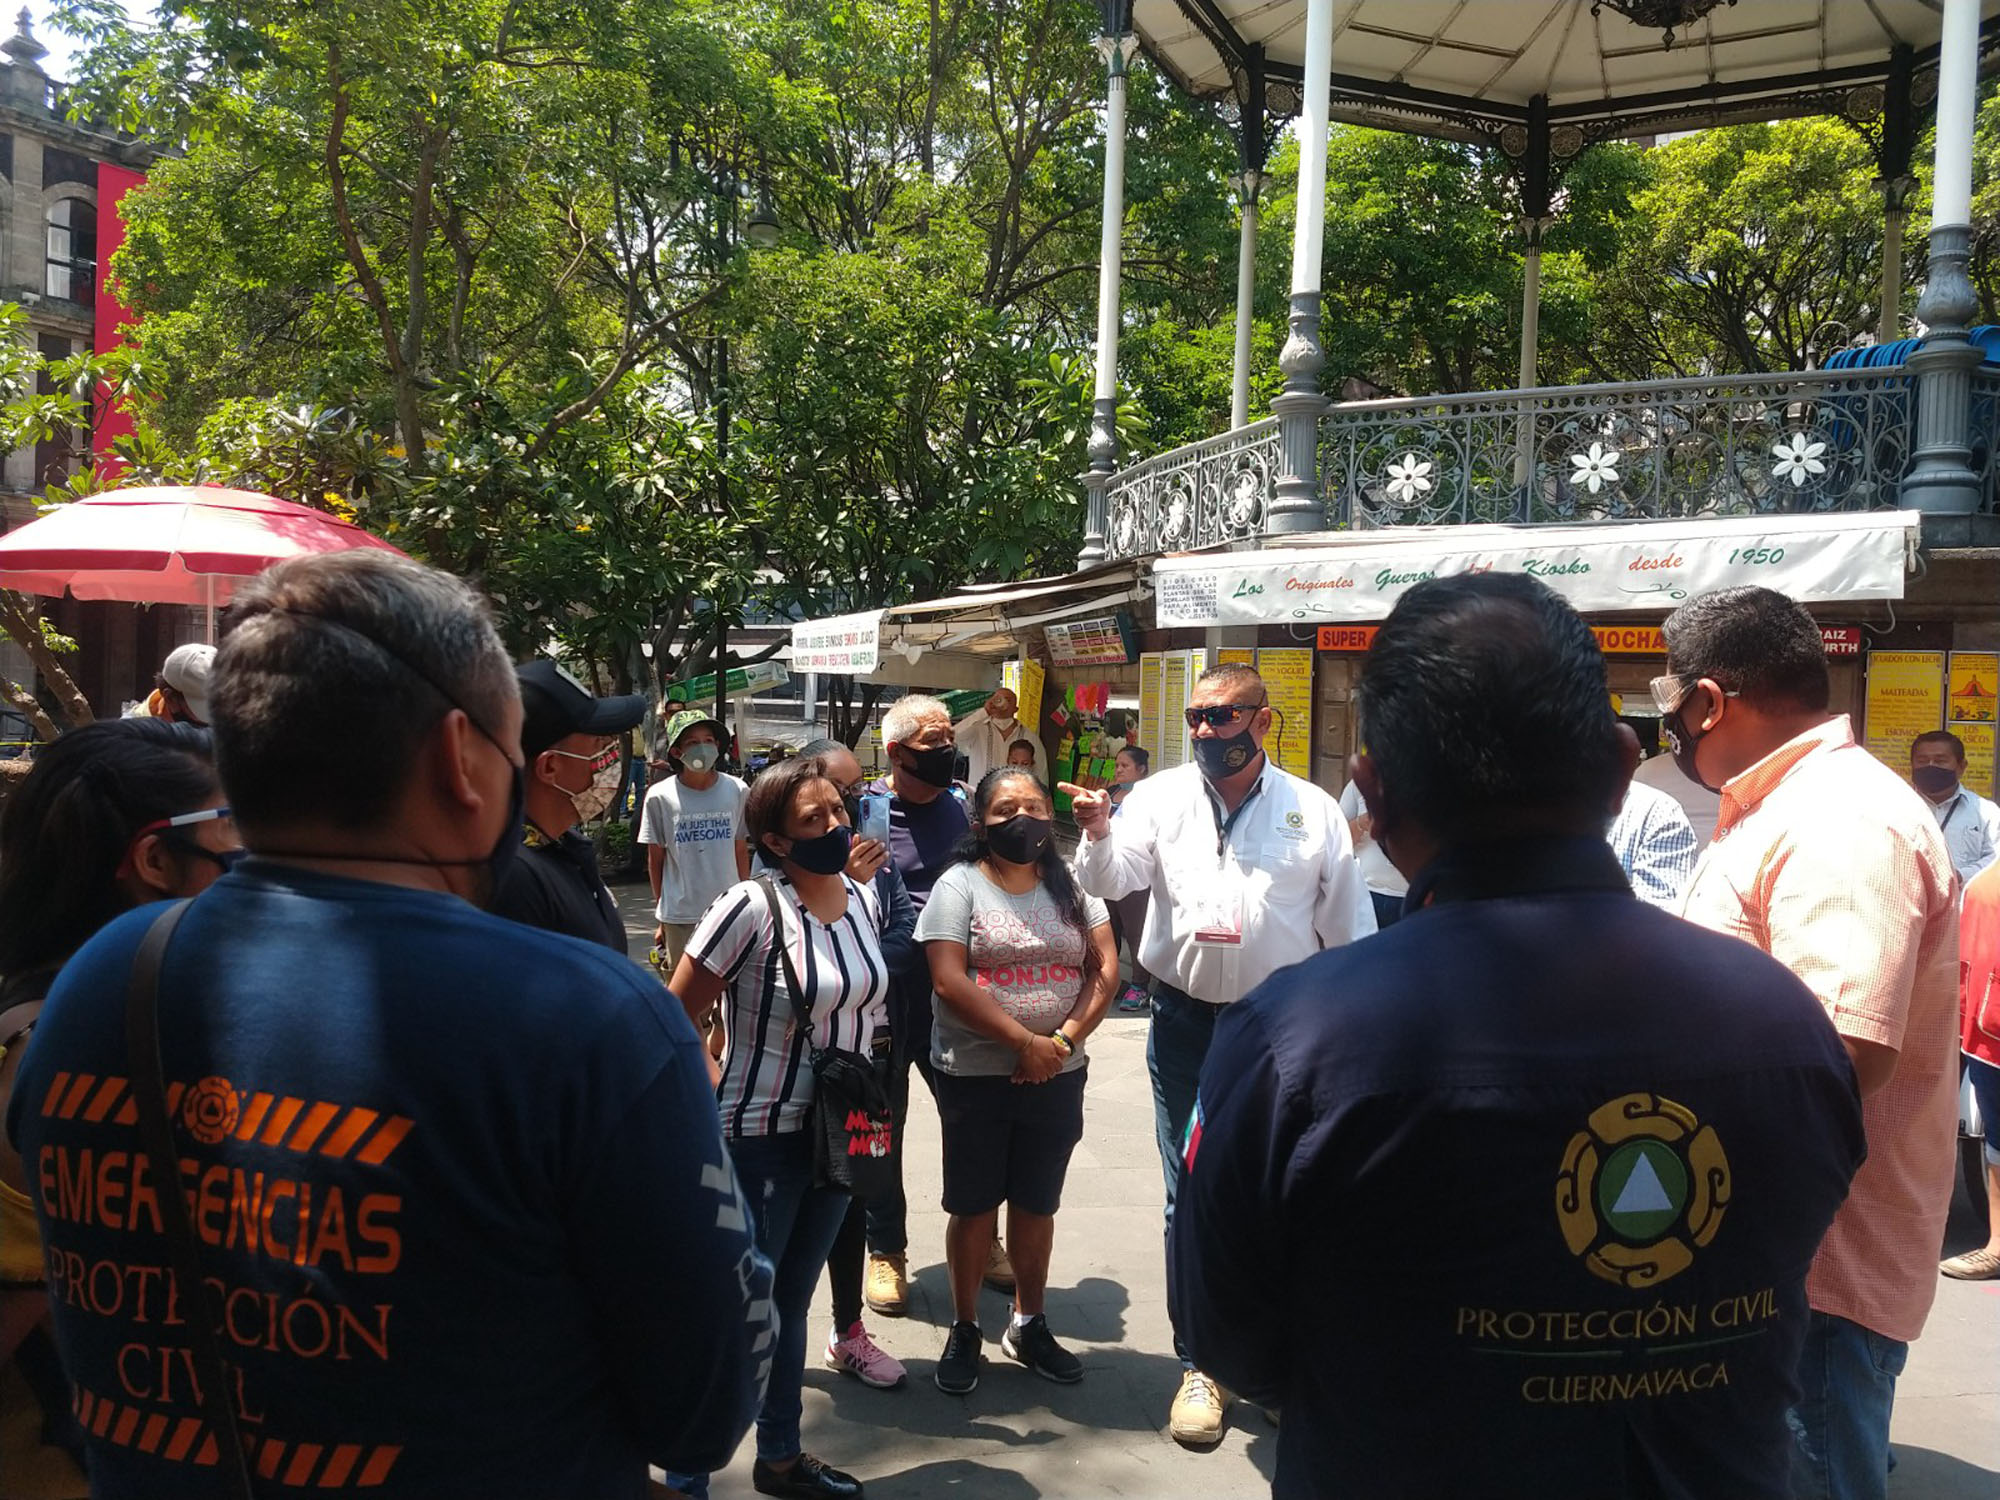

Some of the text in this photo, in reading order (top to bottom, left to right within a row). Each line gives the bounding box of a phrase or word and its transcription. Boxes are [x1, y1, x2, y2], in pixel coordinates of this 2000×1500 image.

[1231, 578, 1265, 598] Los
[1285, 576, 1354, 594] Originales
[1375, 568, 1437, 591] Gueros
[1522, 557, 1591, 577] Kiosko
[1628, 553, 1683, 571] desde
[1728, 548, 1785, 565] 1950
[1322, 630, 1367, 647] SUPER
[1880, 688, 1929, 697] MALTEADAS
[689, 820, 710, 830] JUST
[711, 818, 731, 828] THAT
[675, 828, 732, 843] AWESOME
[1456, 1288, 1782, 1342] PROTECCIÓN CIVIL
[1521, 1361, 1730, 1404] CUERNAVACA
